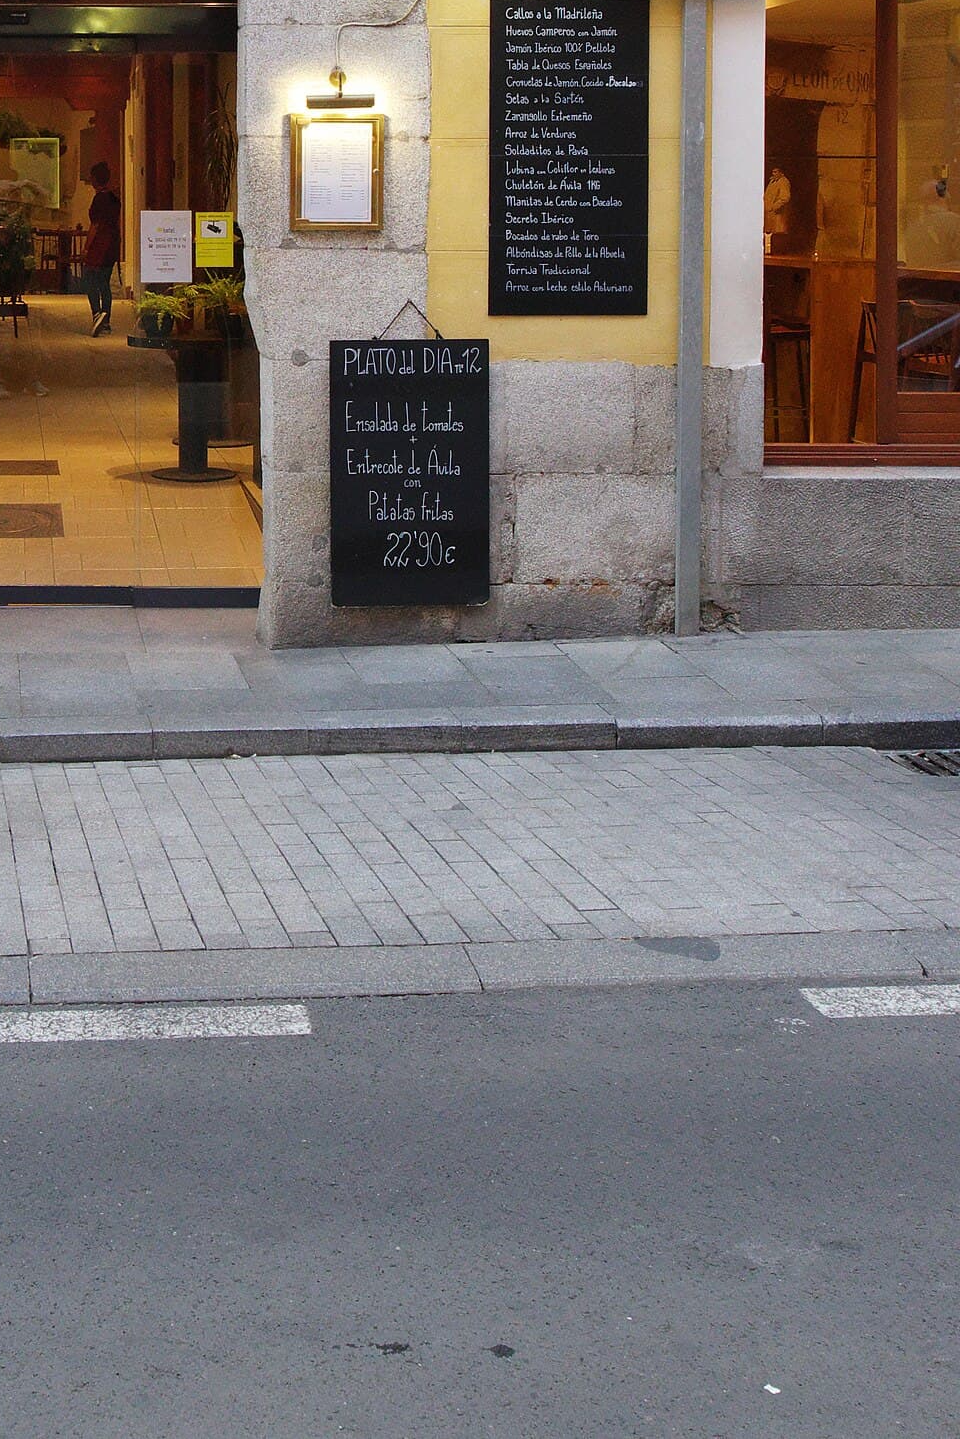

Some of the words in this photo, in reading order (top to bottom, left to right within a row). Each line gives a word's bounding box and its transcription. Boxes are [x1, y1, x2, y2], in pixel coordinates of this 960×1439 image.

[506, 8, 534, 20] Callos
[544, 8, 552, 20] la
[555, 7, 603, 20] Madrileña
[506, 25, 533, 37] Huevos
[591, 25, 618, 37] Jamón
[506, 42, 532, 53] Jamón
[534, 42, 562, 53] Ibérico
[586, 42, 616, 53] Bellota
[506, 59, 529, 70] Tabla
[532, 59, 540, 70] de
[542, 59, 570, 70] Quesos
[575, 59, 612, 70] Españoles
[506, 93, 529, 104] Setas
[542, 93, 549, 104] la
[554, 93, 584, 104] Sartén
[552, 110, 592, 122] Extremeño
[505, 127, 528, 138] Arroz
[531, 127, 539, 138] de
[541, 127, 576, 138] Verduras
[505, 144, 551, 156] Soldaditos
[555, 144, 565, 156] de
[569, 144, 588, 156] Pavía
[506, 160, 534, 175] Lubina
[505, 179, 545, 190] Chuletón
[548, 179, 558, 190] de
[560, 176, 581, 190] Ávila
[505, 196, 542, 207] Manitas
[544, 196, 554, 207] de
[555, 196, 577, 207] Cerdo
[592, 196, 622, 207] Bacalao
[505, 212, 538, 224] Secreto
[541, 212, 574, 224] Ibérico
[506, 230, 538, 241] Bocados
[541, 230, 550, 241] de
[552, 230, 568, 241] rabo
[570, 230, 580, 241] de
[582, 230, 599, 241] Toro
[506, 246, 553, 258] Albóndigas
[555, 246, 564, 258] de
[565, 246, 582, 258] Pollo
[600, 246, 625, 258] Abuela
[506, 263, 537, 275] Torrija
[539, 263, 591, 275] Tradicional
[506, 281, 529, 292] Arroz
[571, 281, 591, 292] estilo
[594, 281, 633, 292] Asturiano
[344, 348, 396, 375] PLATO
[399, 350, 415, 374] del
[346, 401, 398, 432] Ensalada
[403, 402, 416, 432] de
[421, 401, 464, 432] tomates
[347, 448, 404, 474] Entrecote
[408, 449, 421, 474] de
[427, 445, 461, 476] Ávila
[404, 478, 421, 488] con
[369, 491, 416, 521] Patatas
[421, 492, 454, 521] fritas
[383, 531, 456, 568] 22'90€
